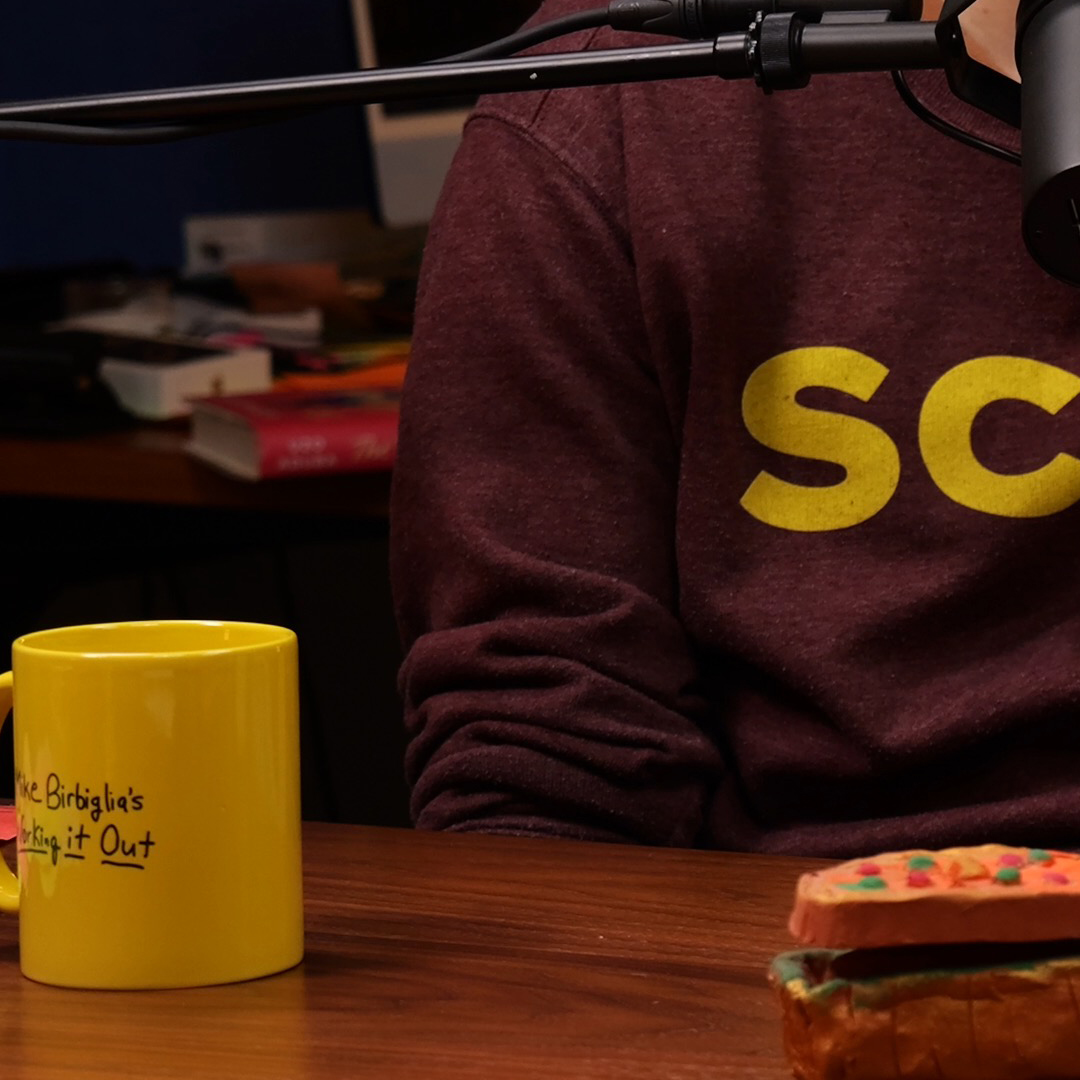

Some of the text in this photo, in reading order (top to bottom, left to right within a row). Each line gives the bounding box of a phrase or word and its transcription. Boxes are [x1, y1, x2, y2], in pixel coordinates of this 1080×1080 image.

[46, 773, 145, 822] Birbiglia's
[67, 825, 91, 851] it
[100, 823, 156, 858] Out
